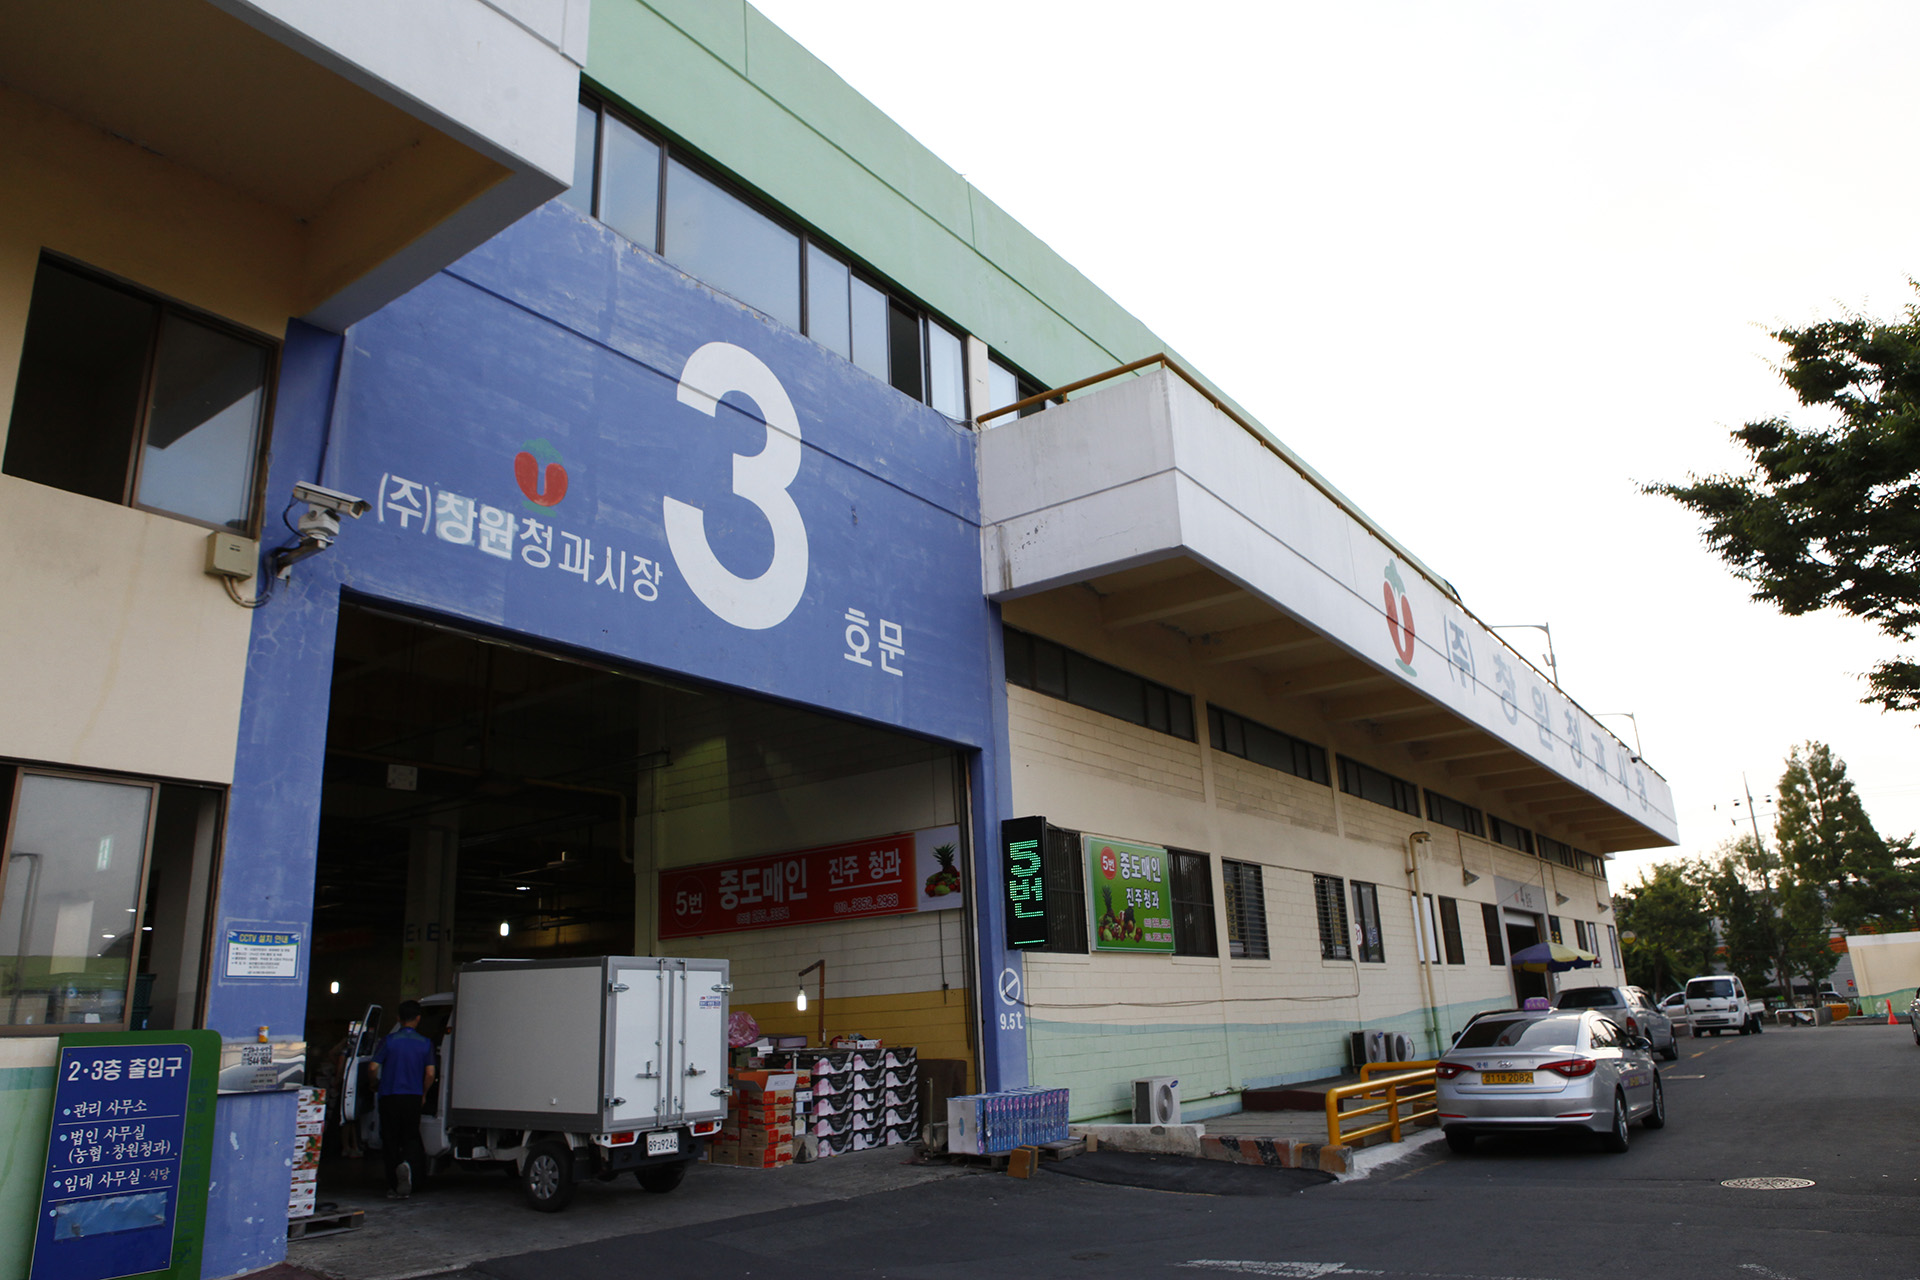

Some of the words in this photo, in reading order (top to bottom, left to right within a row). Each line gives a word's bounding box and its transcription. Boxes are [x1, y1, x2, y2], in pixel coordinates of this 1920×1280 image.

[663, 341, 809, 630] 3
[377, 471, 664, 602] (주)창원청과시장
[844, 607, 905, 677] 호문
[829, 854, 859, 884] 진주
[868, 848, 902, 880] 청과
[1102, 855, 1115, 872] 5번
[1119, 851, 1162, 883] 중도매인
[675, 890, 703, 916] 5번
[718, 858, 808, 910] 중도매인
[1125, 887, 1160, 910] 진주청과
[239, 933, 258, 942] CCTV
[274, 934, 289, 944] 안내
[1000, 1011, 1023, 1031] 9.5t
[128, 1057, 182, 1079] 출입구
[73, 1100, 102, 1118] 관리
[106, 1099, 147, 1116] 사무소
[70, 1127, 99, 1146] 법인
[103, 1123, 145, 1143] 사무실
[65, 1173, 94, 1193] 임대
